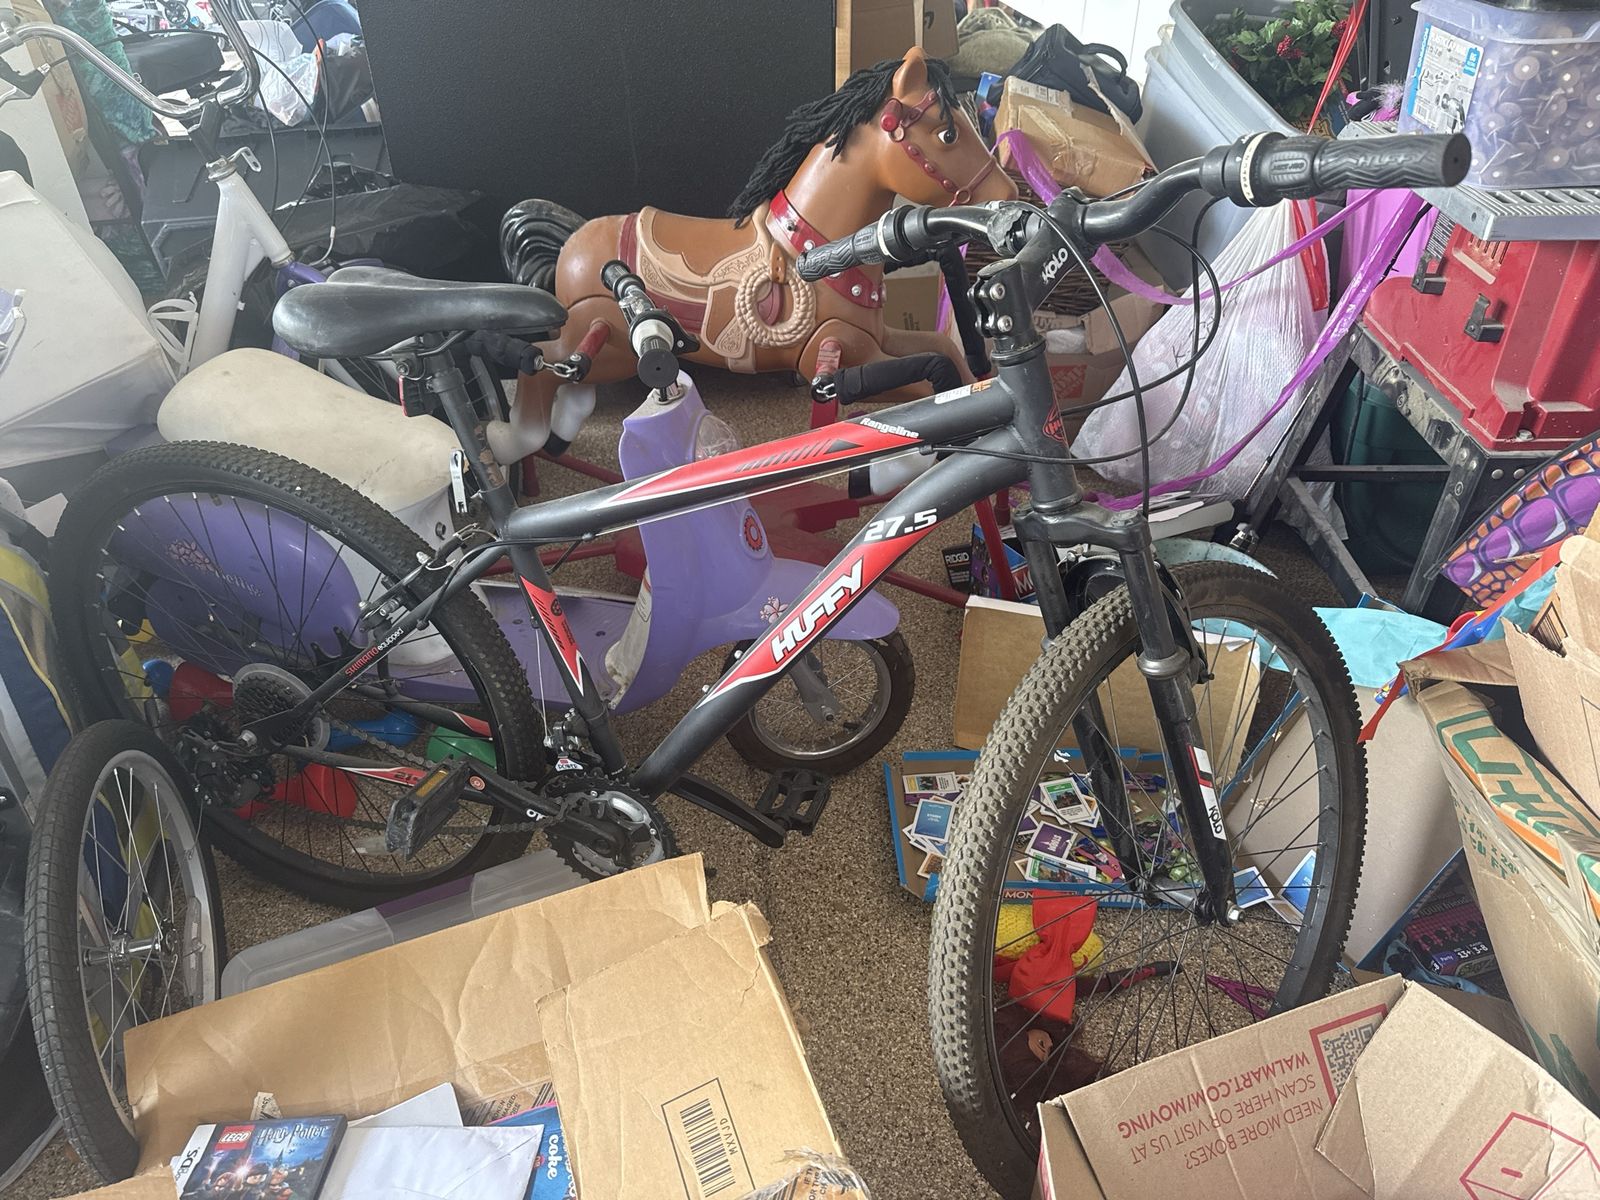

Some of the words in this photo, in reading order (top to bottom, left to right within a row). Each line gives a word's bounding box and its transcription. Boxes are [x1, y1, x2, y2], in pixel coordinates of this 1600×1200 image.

[1356, 152, 1427, 168] HUFFY
[1041, 247, 1069, 285] KOLO
[860, 417, 919, 439] Rangeline
[863, 508, 938, 542] 27.5
[944, 551, 970, 564] RIDGID
[770, 555, 865, 664] HUFFY
[344, 646, 379, 677] SHIMANO
[377, 627, 404, 651] equipped
[1208, 804, 1222, 834] KOLO
[1472, 944, 1489, 955] 3-8
[1117, 1051, 1311, 1139] WALMART.COM/MOVING
[1275, 1074, 1316, 1102] SCAN
[1208, 1108, 1233, 1129] OR
[1234, 1091, 1274, 1120] HERE
[1283, 1097, 1324, 1125] NEED
[220, 1133, 250, 1143] LEGO
[255, 1127, 289, 1146] Harry
[287, 1123, 330, 1149] Potter
[719, 1117, 738, 1156] MXVJD
[1174, 1119, 1209, 1147] VISIT
[1241, 1114, 1280, 1145] MORE
[547, 1134, 562, 1180] coke
[1130, 1144, 1147, 1165] AT
[1150, 1134, 1172, 1155] US
[1185, 1134, 1238, 1170] BOXES?
